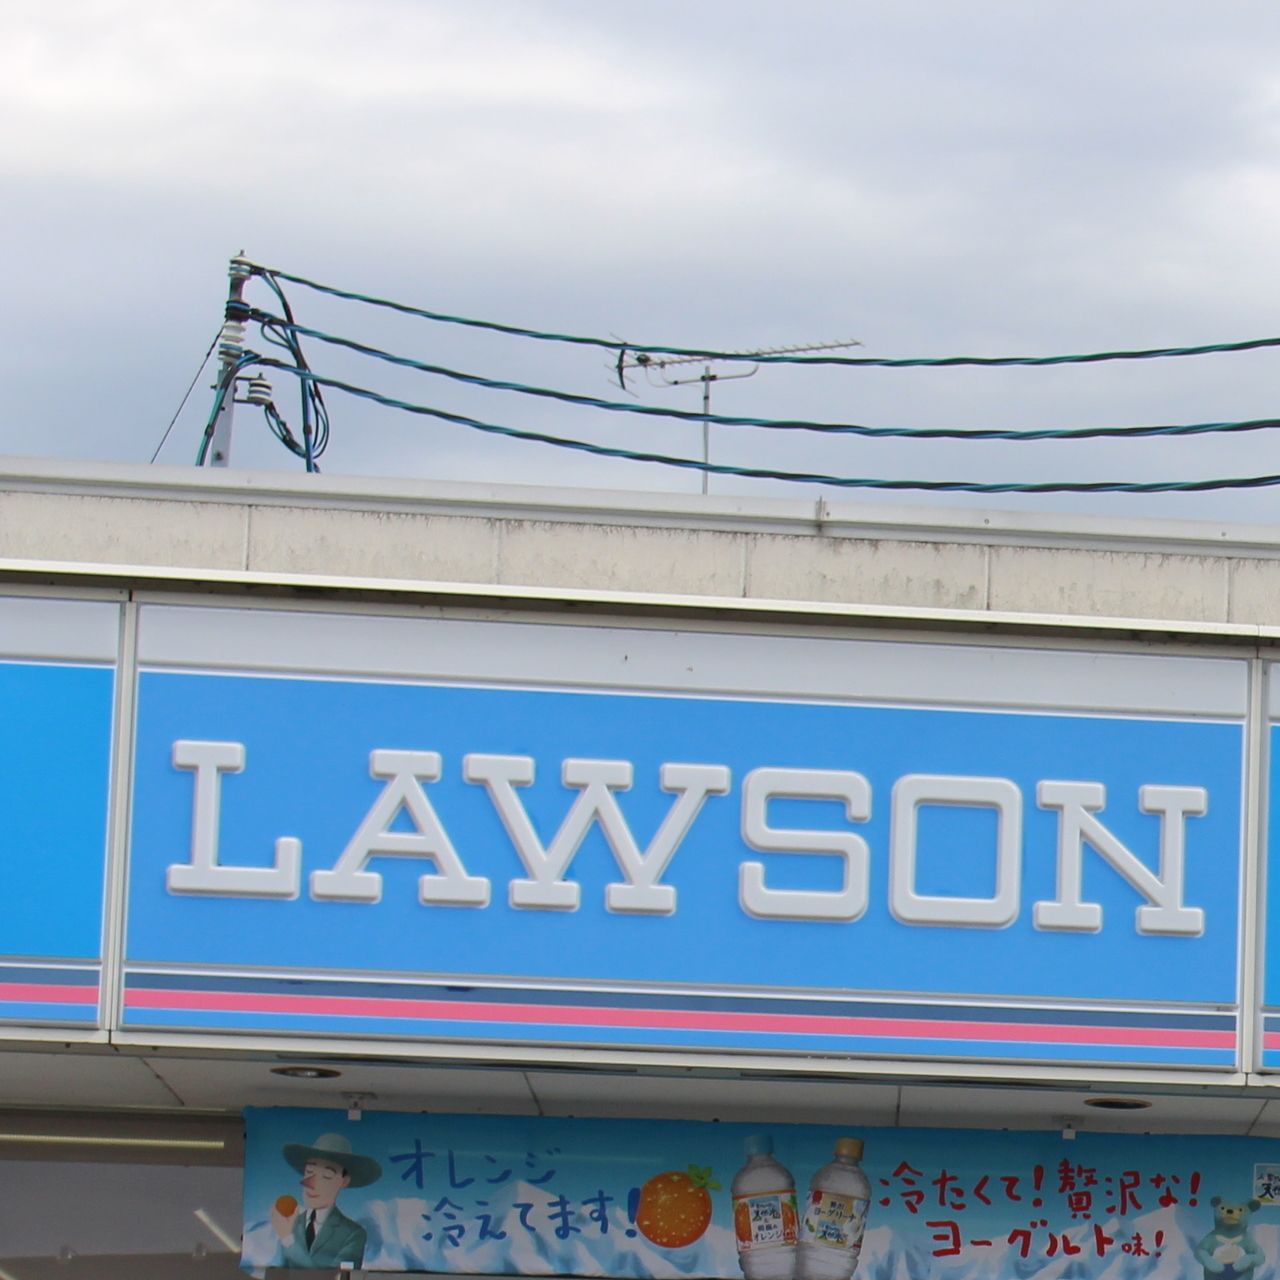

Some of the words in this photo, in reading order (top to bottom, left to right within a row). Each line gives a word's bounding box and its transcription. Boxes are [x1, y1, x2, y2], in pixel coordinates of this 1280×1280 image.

[166, 739, 1208, 937] LAWSON
[389, 1138, 562, 1190] オレンジ
[422, 1187, 641, 1247] 冷えてます!
[925, 1219, 1165, 1259] ヨーグルト味!
